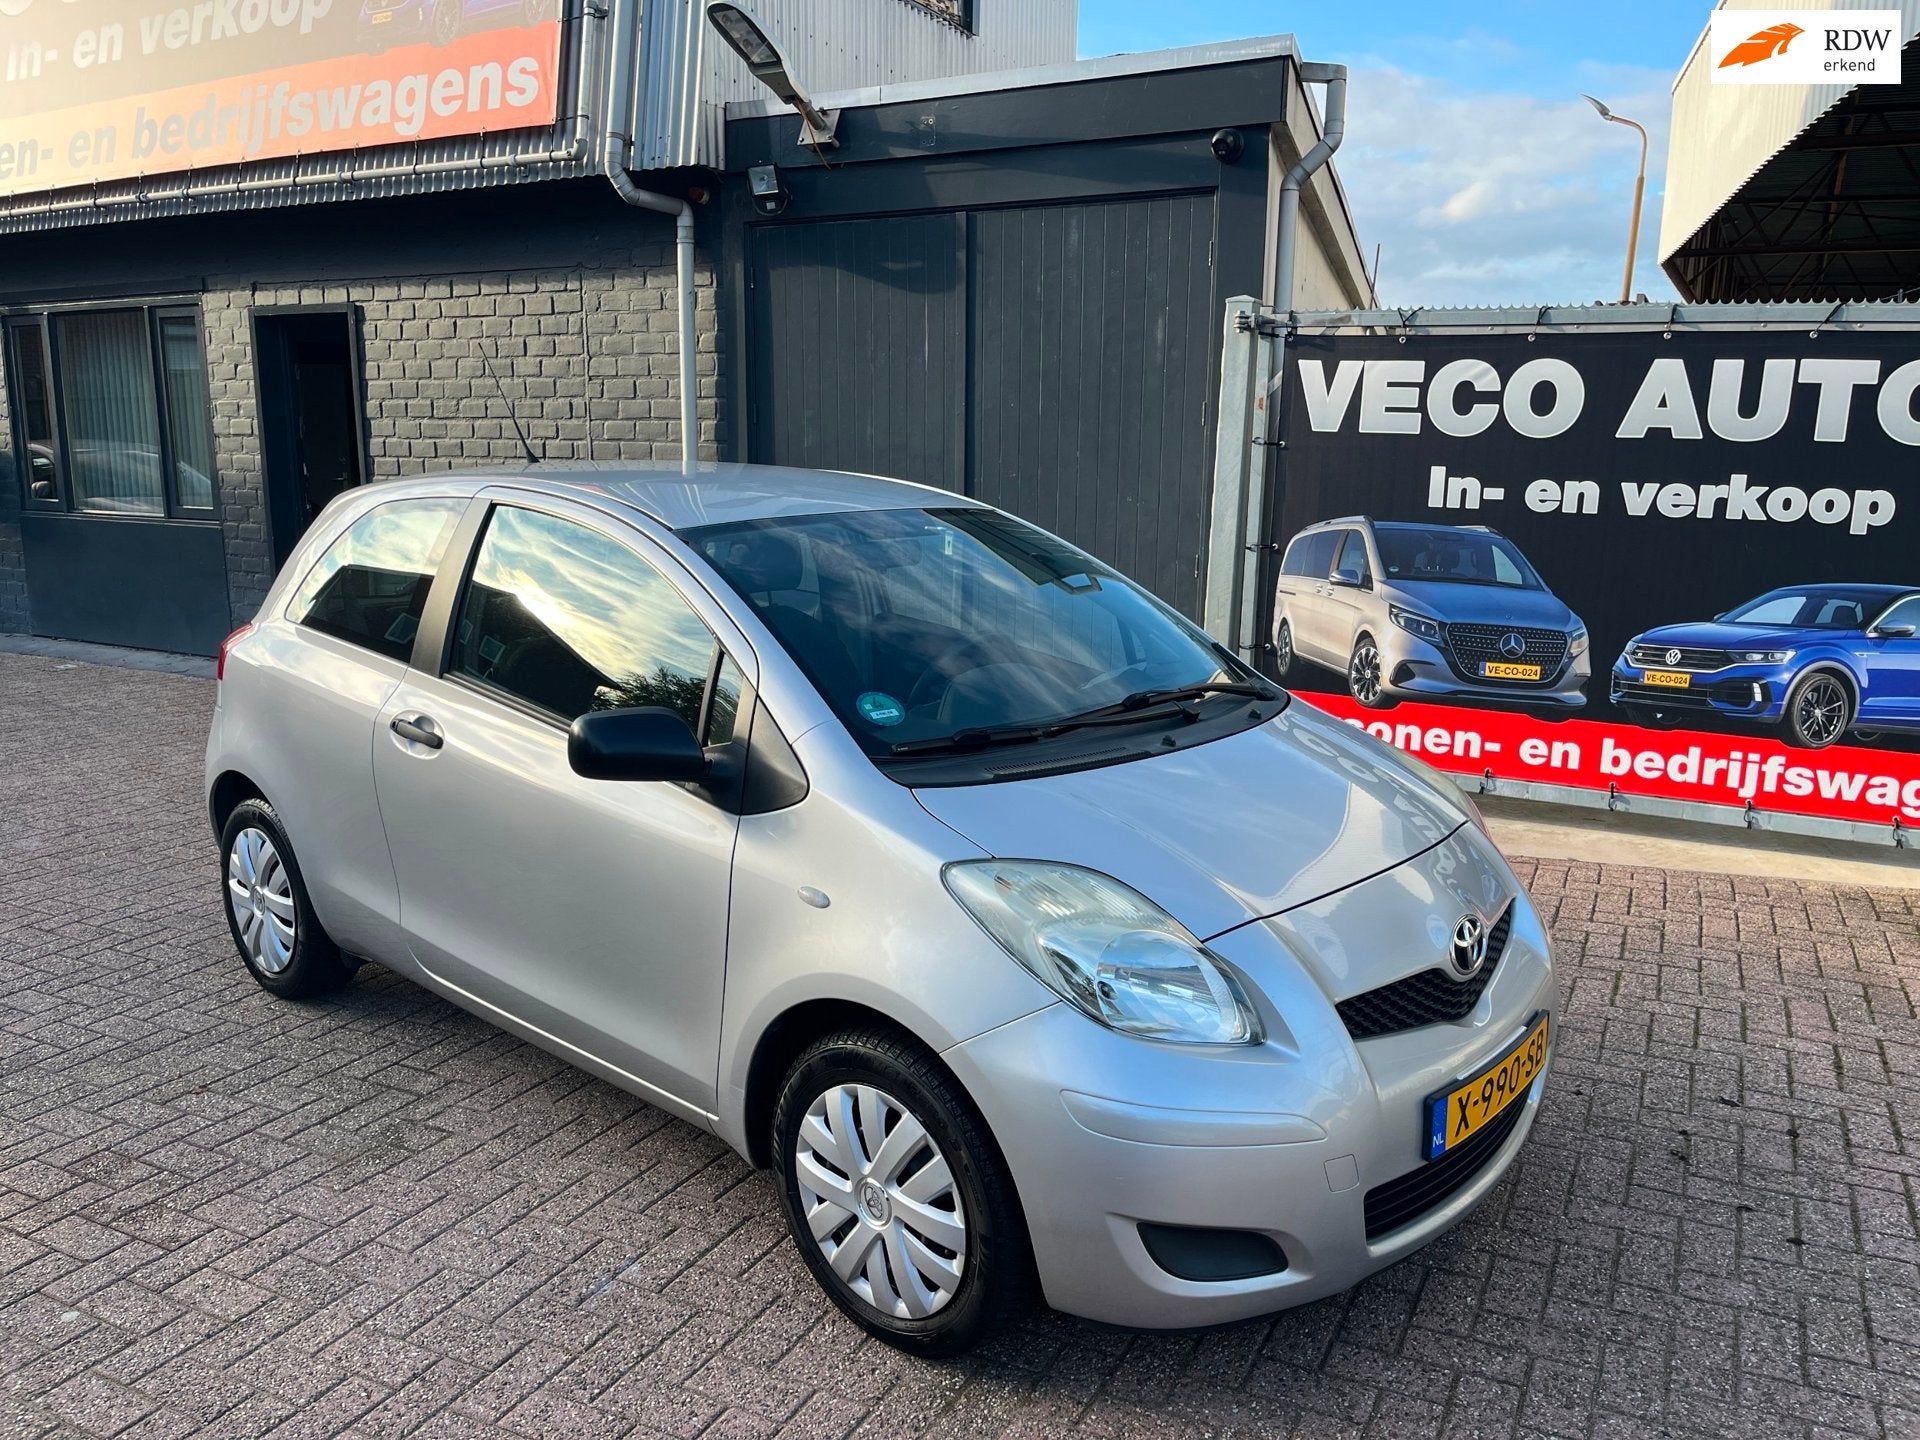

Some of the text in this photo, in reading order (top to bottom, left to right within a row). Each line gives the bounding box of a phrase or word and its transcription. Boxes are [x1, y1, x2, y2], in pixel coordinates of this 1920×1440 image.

[73, 22, 124, 69] en
[140, 0, 332, 55] verkoop
[68, 126, 117, 169] en
[132, 55, 540, 161] bedrijfswagens
[1298, 357, 1586, 439] VECO
[1428, 465, 1896, 536] In- en verkoop
[1487, 665, 1539, 678] VE-CO-024
[1646, 673, 1688, 685] VE-CO-024
[1336, 717, 1501, 759] onen-
[1519, 738, 1580, 770] en
[1455, 1028, 1545, 1138] X-990-SB
[1432, 1131, 1445, 1148] NL
